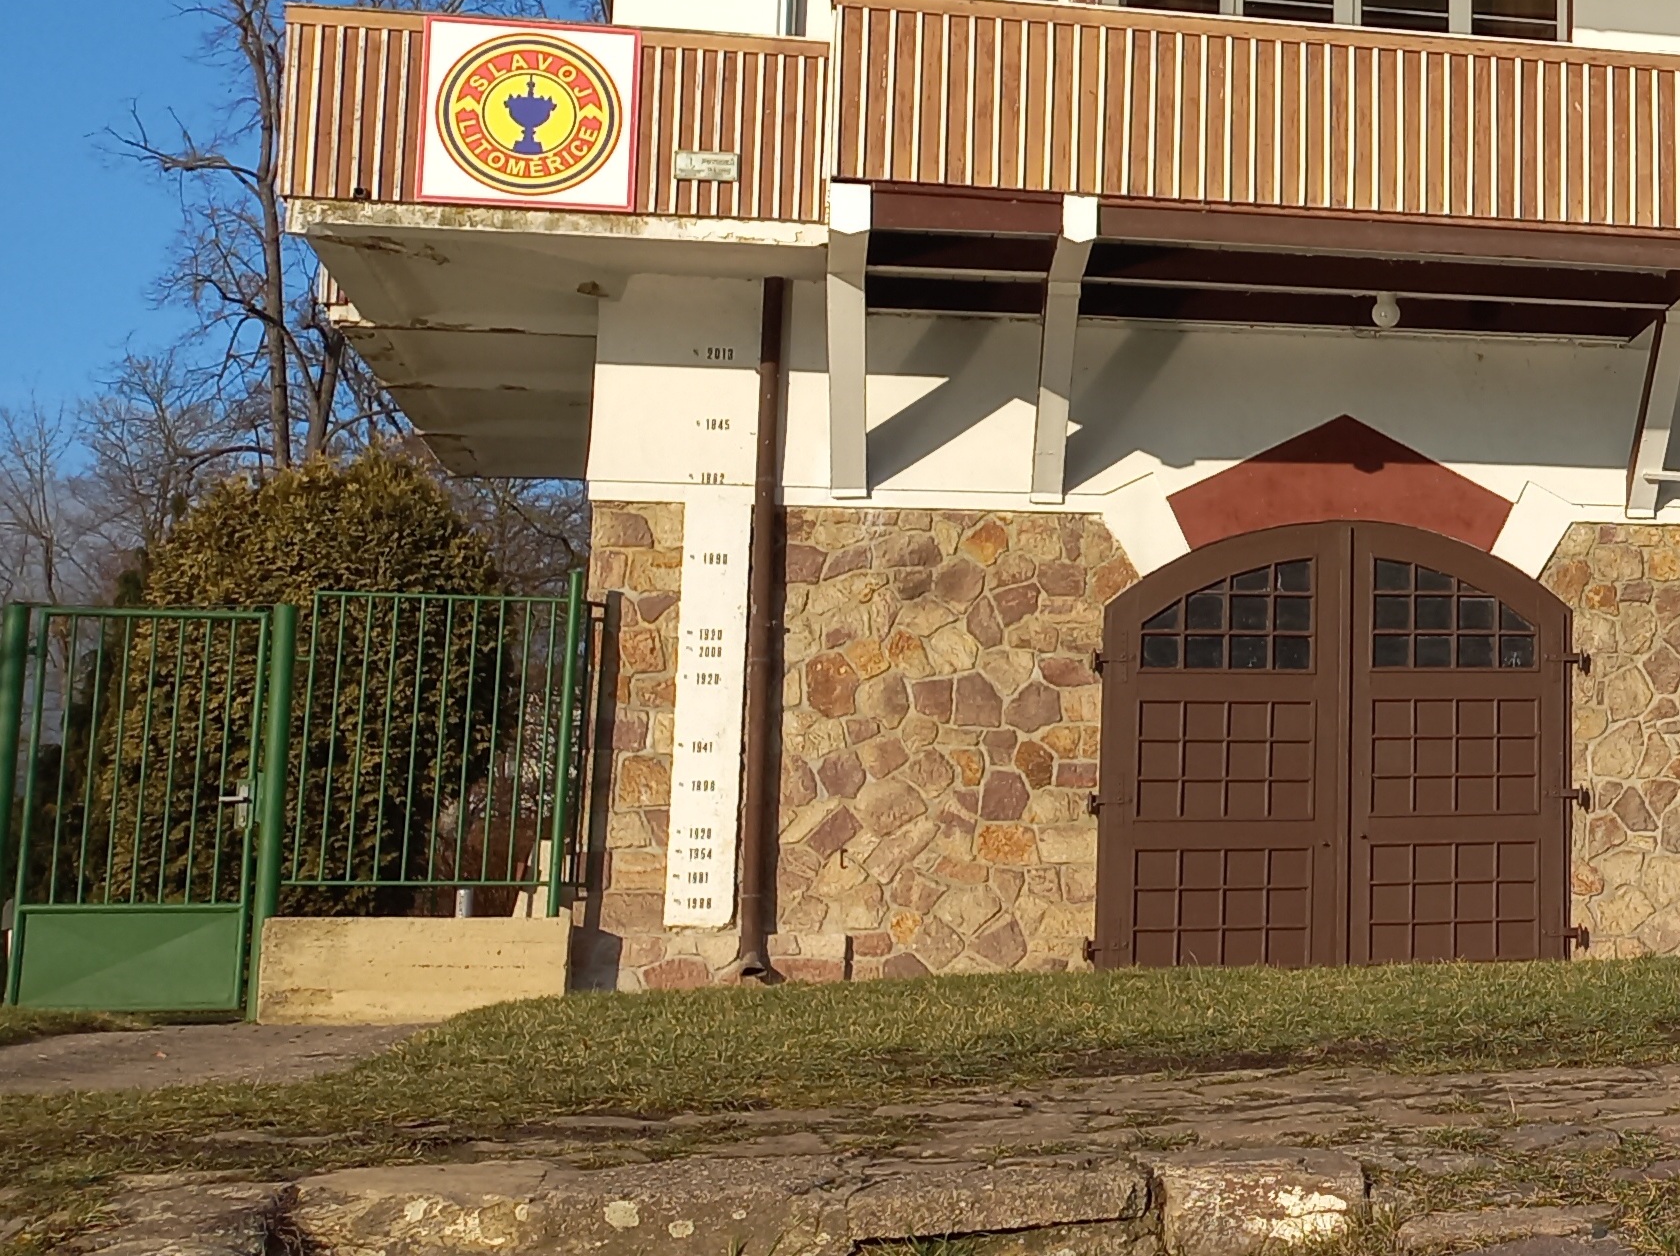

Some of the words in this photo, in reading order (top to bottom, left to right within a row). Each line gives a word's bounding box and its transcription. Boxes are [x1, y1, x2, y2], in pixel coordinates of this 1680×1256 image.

[469, 53, 593, 98] SLAVOJ
[459, 119, 598, 177] LITOMĚŘICE
[707, 348, 734, 360] 2013
[706, 419, 731, 431] 1845
[699, 629, 722, 641] 1920
[696, 673, 721, 685] 1920
[692, 742, 713, 753] 1941
[687, 872, 709, 884] 1981
